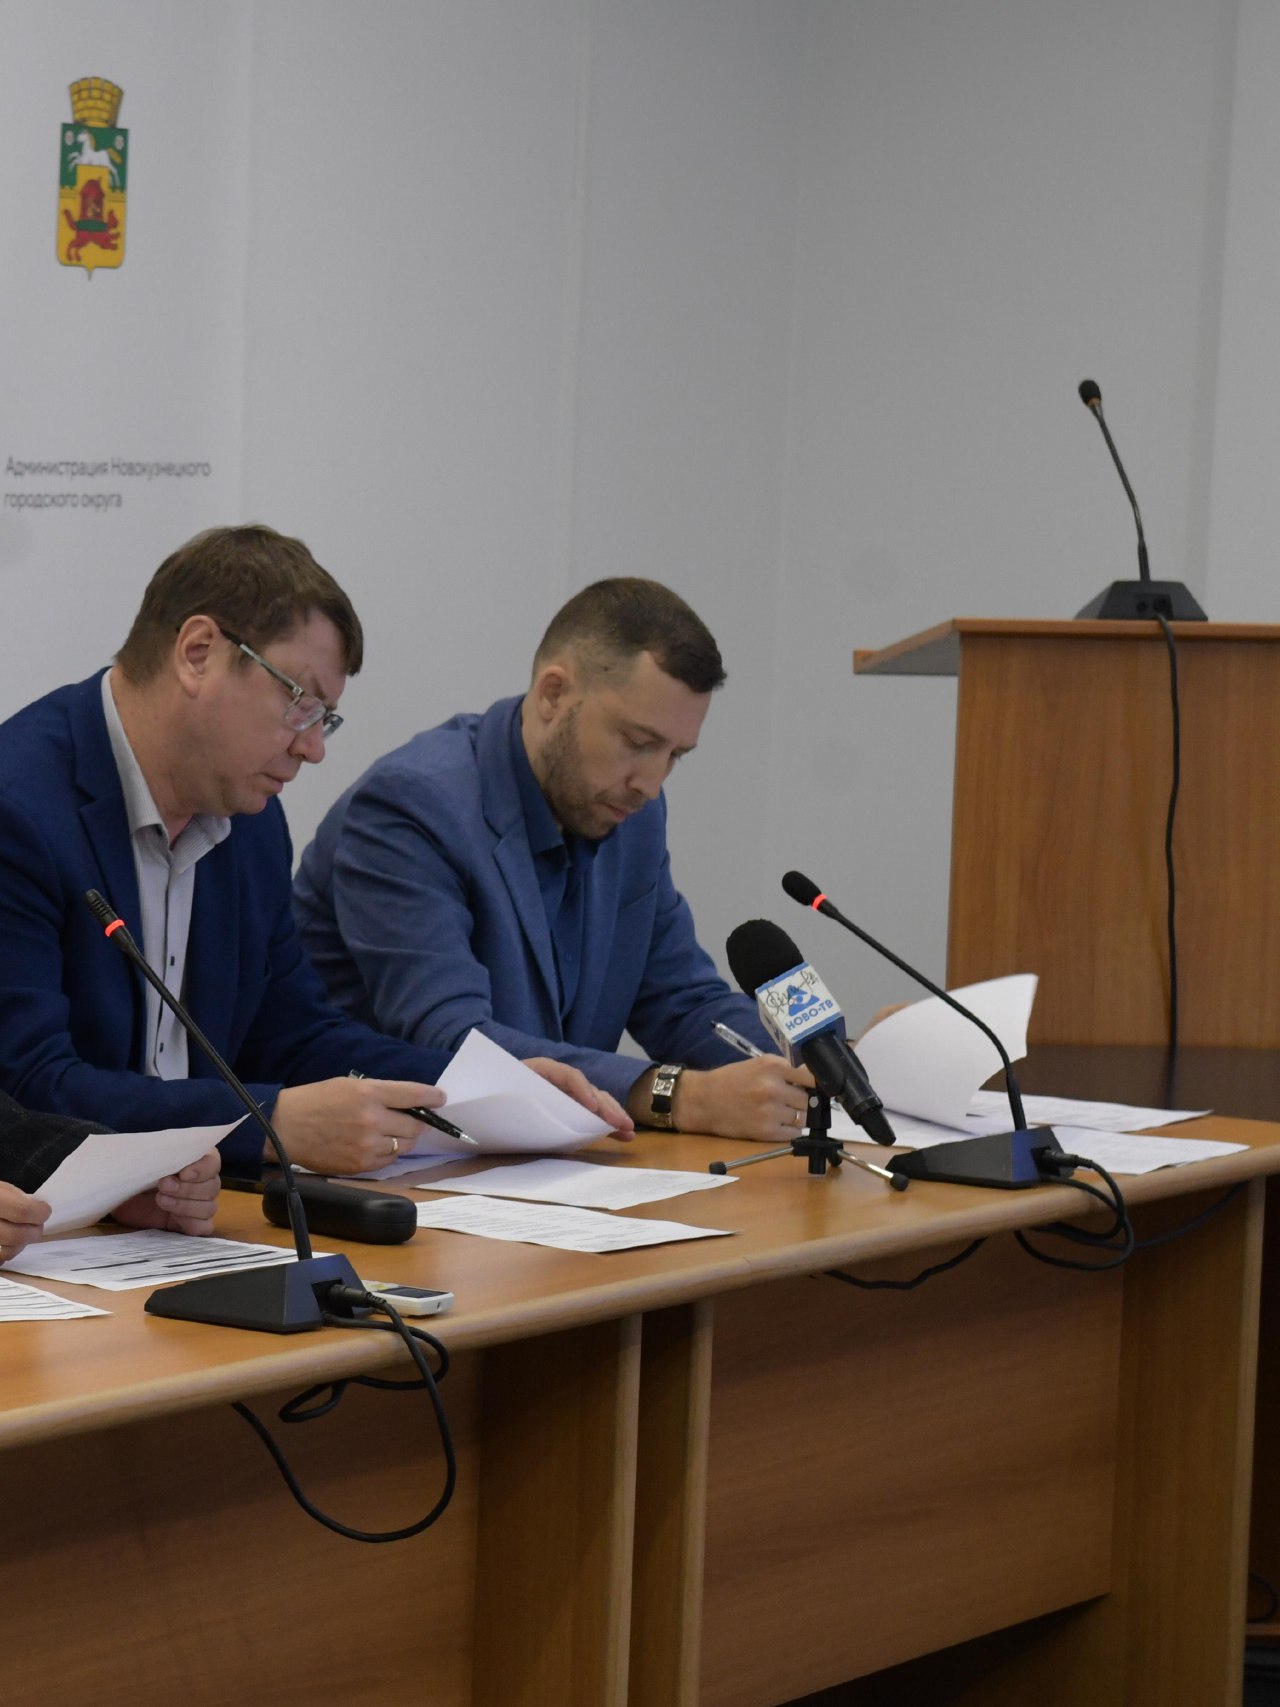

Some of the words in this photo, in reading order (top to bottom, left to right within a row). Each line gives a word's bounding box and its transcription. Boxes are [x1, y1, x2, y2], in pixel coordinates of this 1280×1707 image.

[5, 456, 109, 480] Администрация
[110, 458, 211, 480] Новокузнецкого
[4, 491, 79, 511] городского
[80, 493, 123, 511] округа
[784, 998, 834, 1031] НОВО-ТВ
